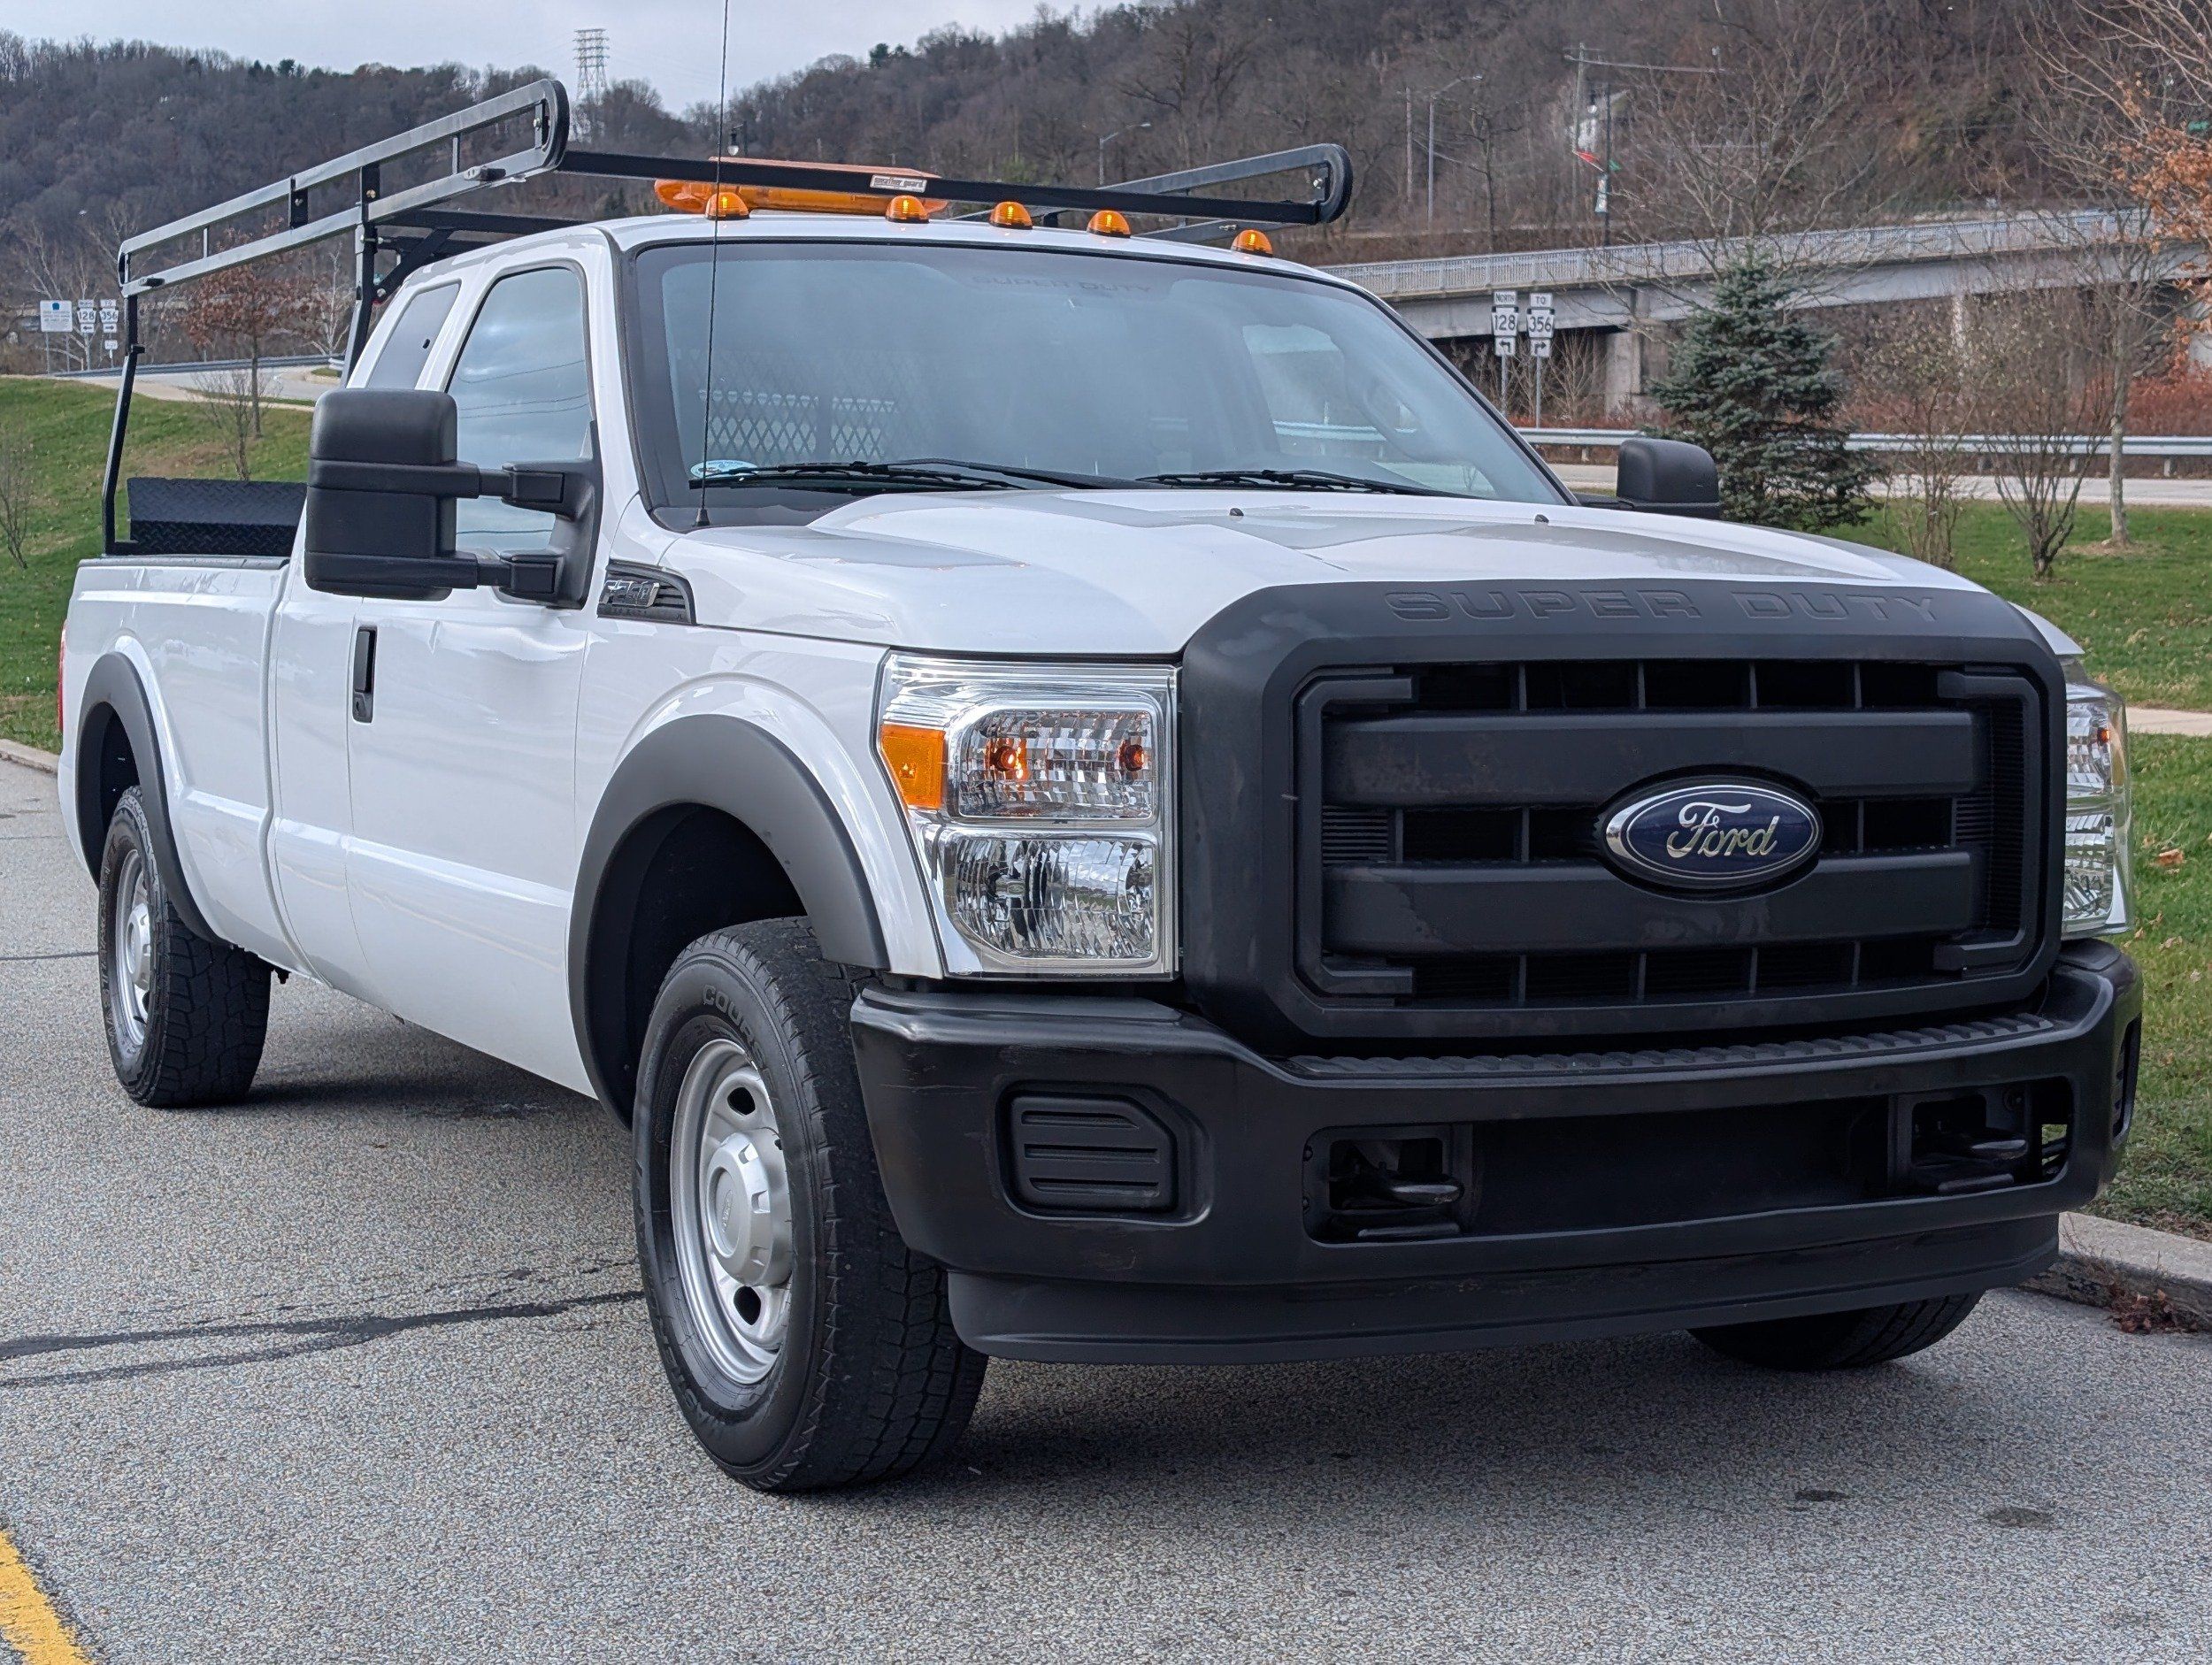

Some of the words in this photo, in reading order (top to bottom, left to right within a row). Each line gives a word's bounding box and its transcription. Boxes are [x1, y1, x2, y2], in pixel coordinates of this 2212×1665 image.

[1495, 294, 1516, 303] NORTH
[1535, 296, 1547, 305] TO
[79, 311, 95, 320] 128
[101, 311, 118, 320] 356
[1494, 314, 1517, 331] 128
[1529, 317, 1552, 333] 356
[1384, 590, 1702, 621] SUPER
[1731, 591, 1939, 623] DUTY
[1666, 802, 1780, 858] Ford
